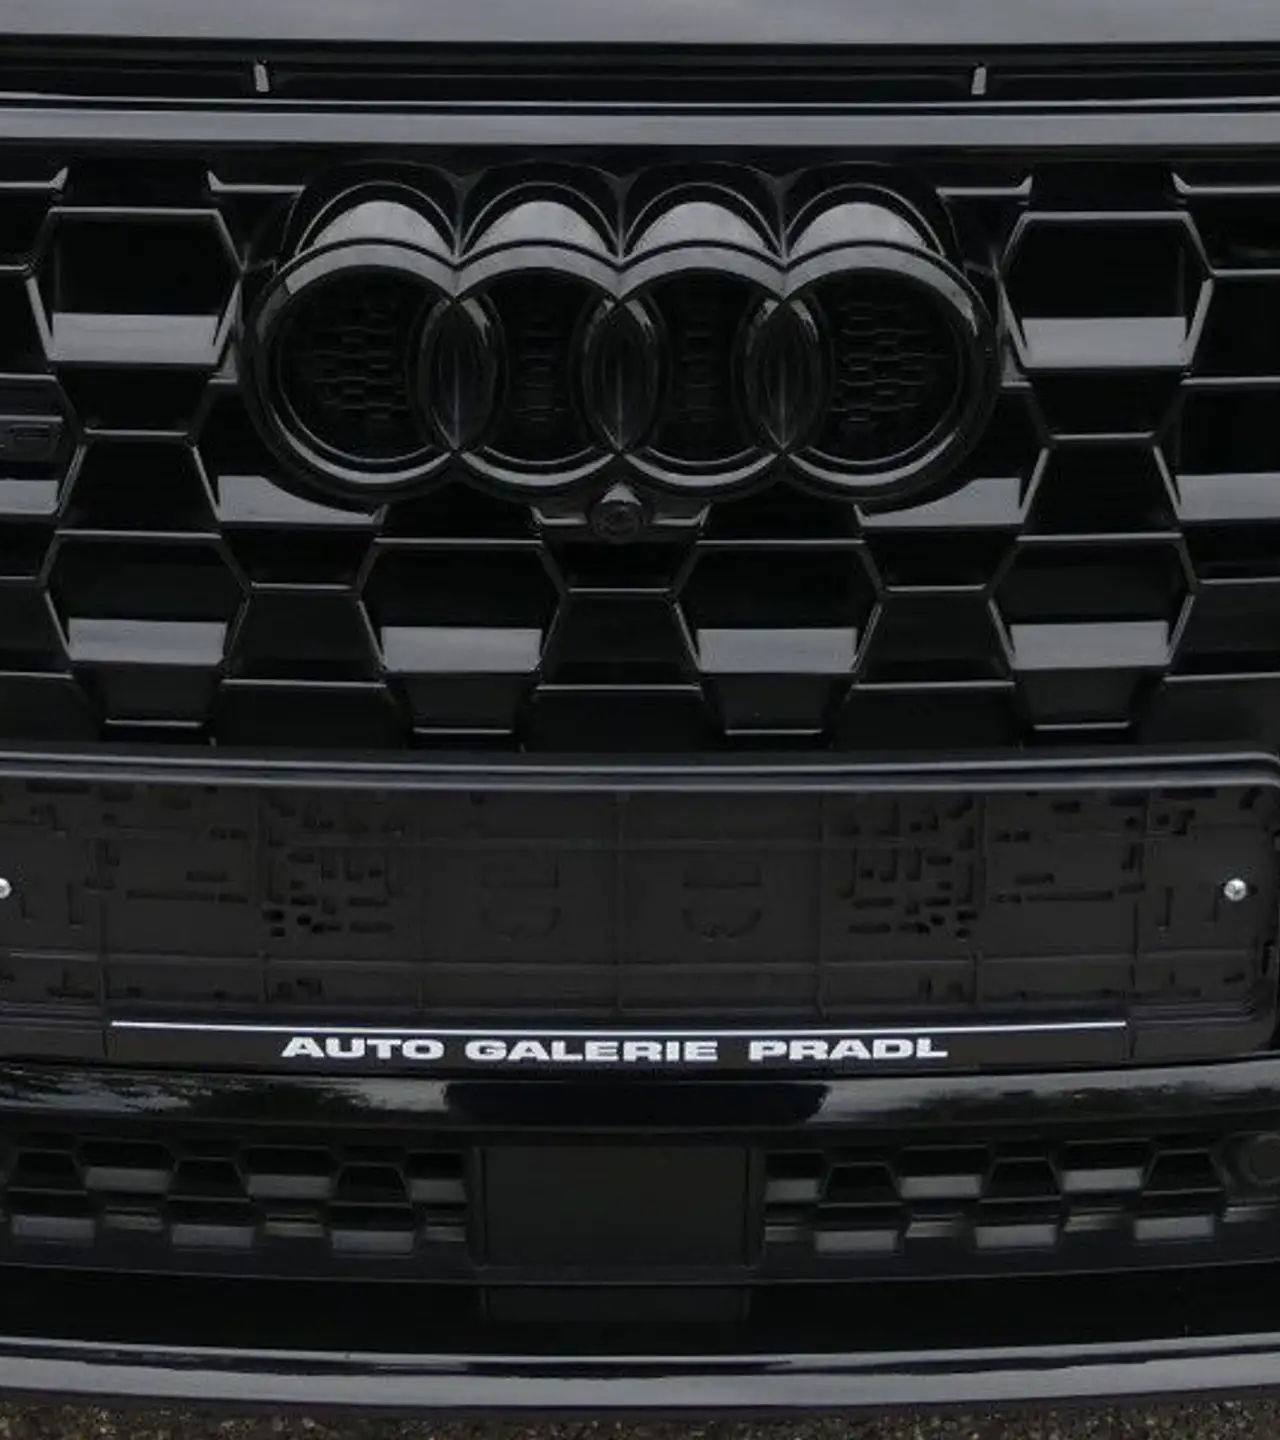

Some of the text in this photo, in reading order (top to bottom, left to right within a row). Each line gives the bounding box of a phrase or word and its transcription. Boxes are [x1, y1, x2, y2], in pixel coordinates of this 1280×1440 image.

[281, 1035, 950, 1062] AUTO GALERIE PRADL
